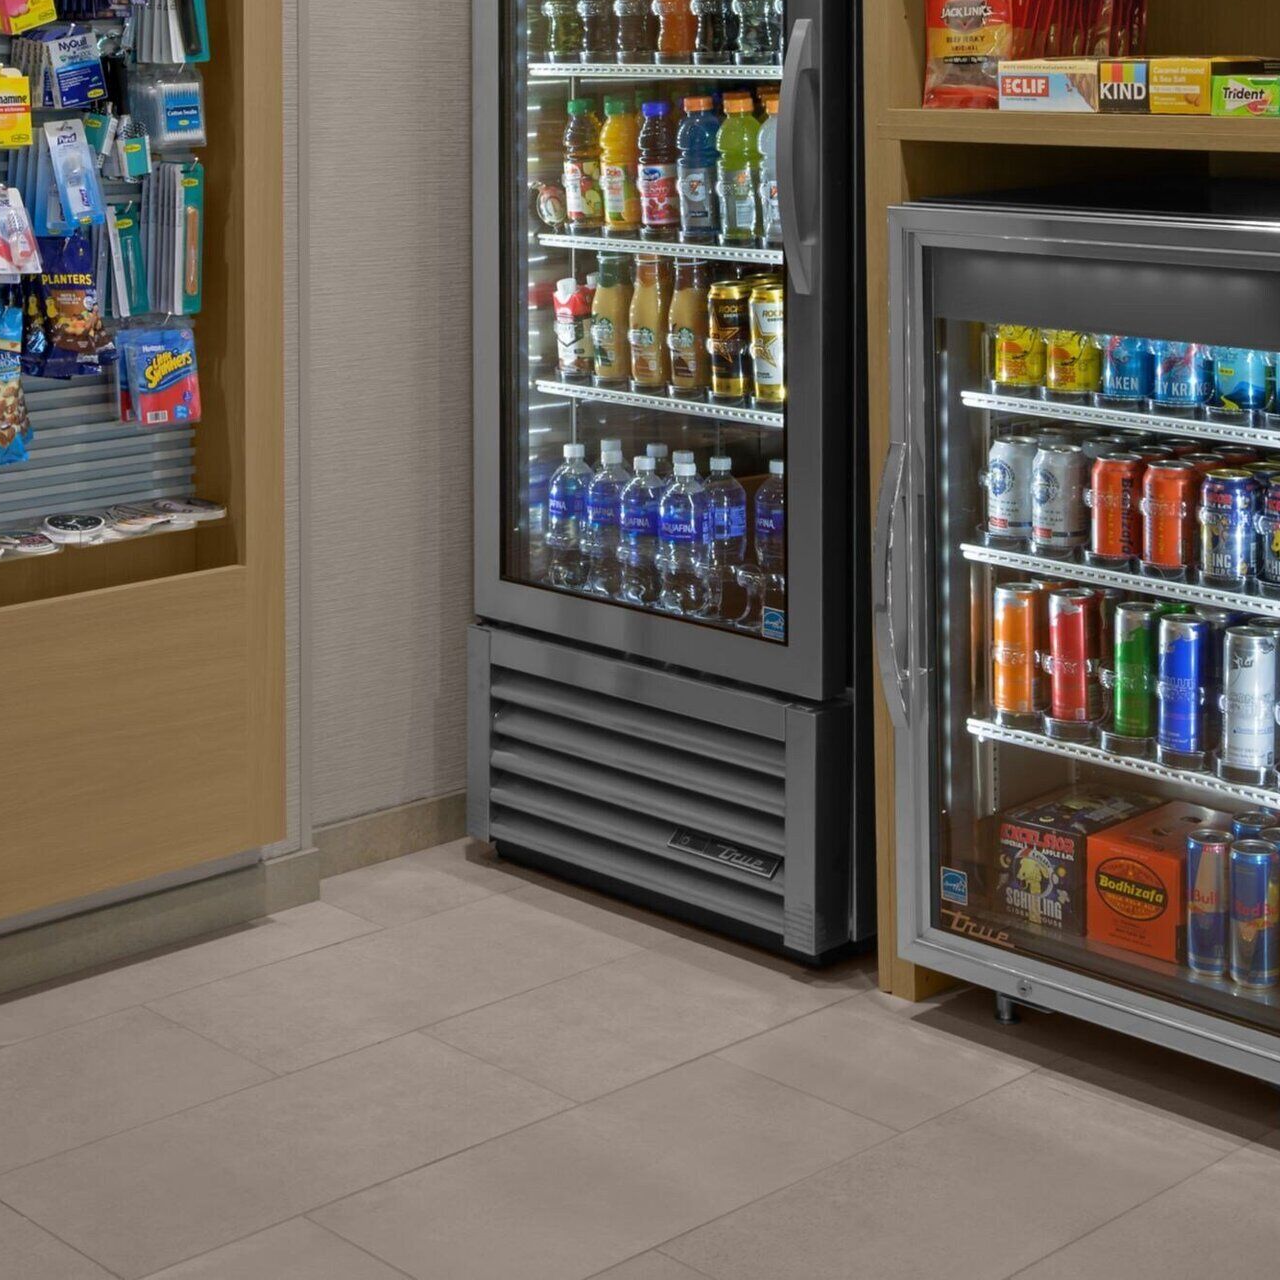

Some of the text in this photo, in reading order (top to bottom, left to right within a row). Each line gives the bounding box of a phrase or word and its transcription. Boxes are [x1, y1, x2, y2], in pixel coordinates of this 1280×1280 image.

[941, 7, 963, 18] JACK
[58, 36, 88, 51] NyQuil
[1153, 66, 1205, 74] Caramel Almond
[1011, 78, 1046, 93] CLIF
[1100, 82, 1147, 100] KIND
[1223, 86, 1265, 100] Trident
[41, 273, 92, 286] PLANTERS
[1109, 376, 1139, 391] AKEN
[1099, 875, 1163, 903] Bodhizafa
